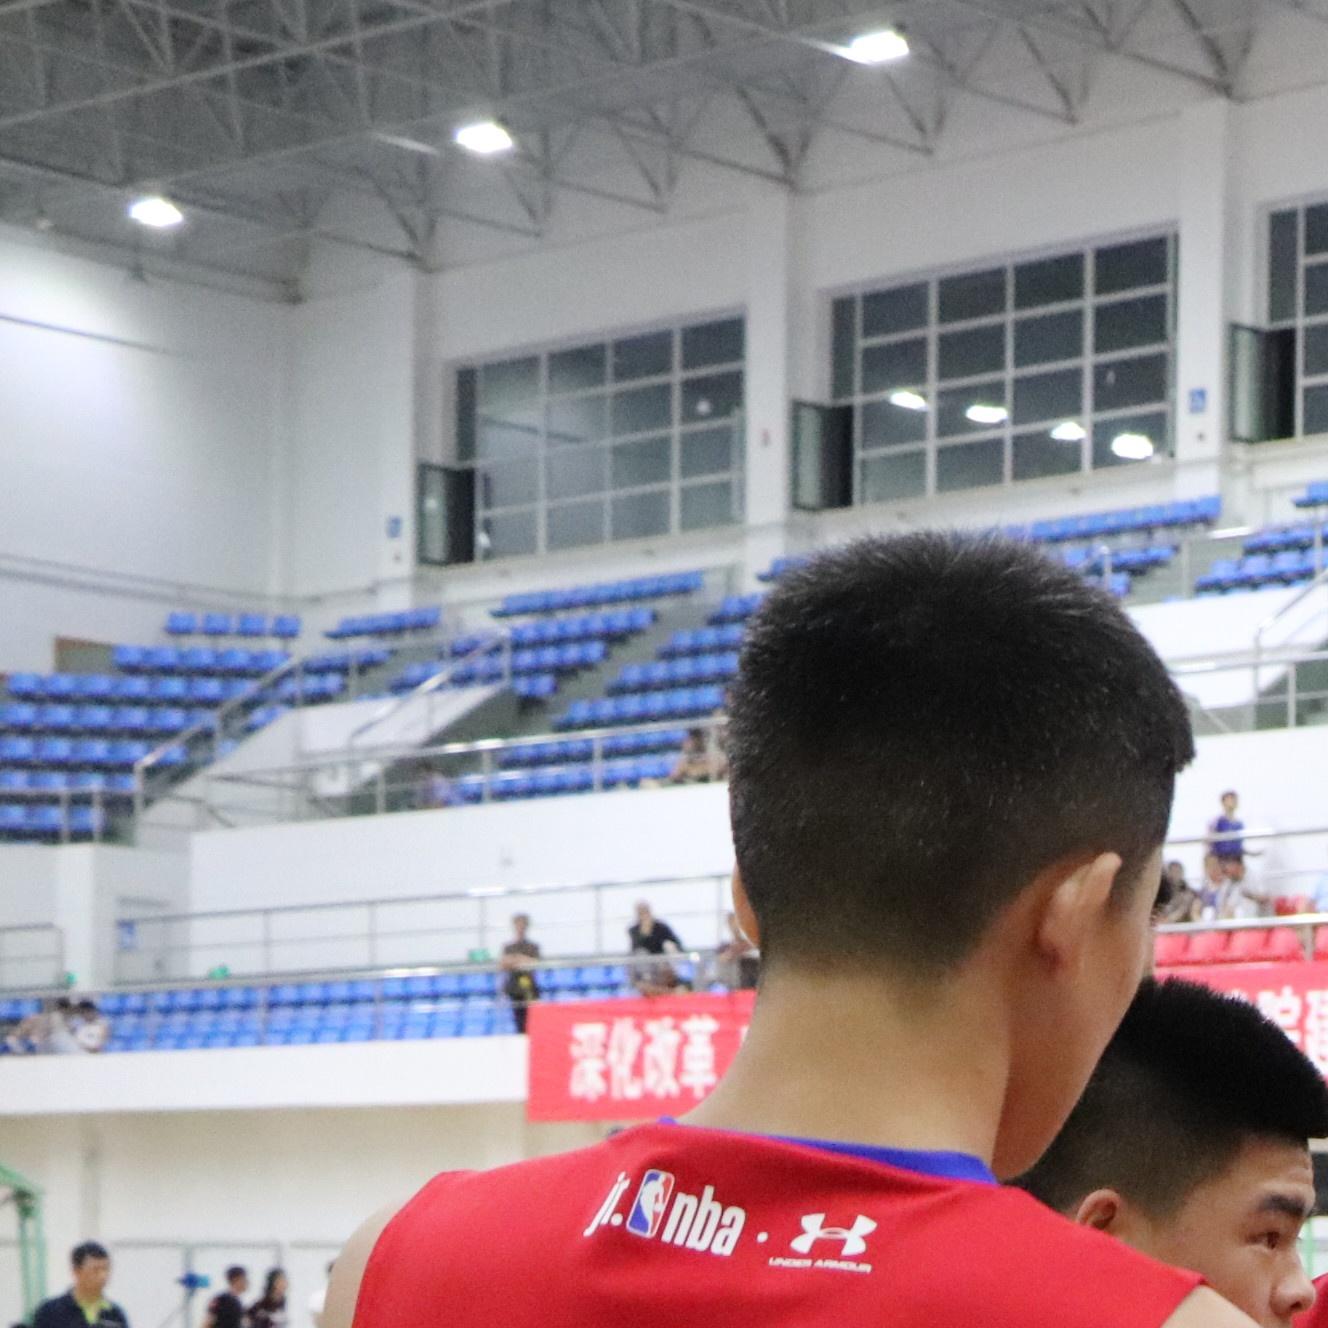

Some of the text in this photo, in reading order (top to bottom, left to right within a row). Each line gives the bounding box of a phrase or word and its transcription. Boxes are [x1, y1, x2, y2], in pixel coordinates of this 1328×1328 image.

[569, 1014, 720, 1101] 深化改革
[583, 1171, 746, 1257] jr. nba
